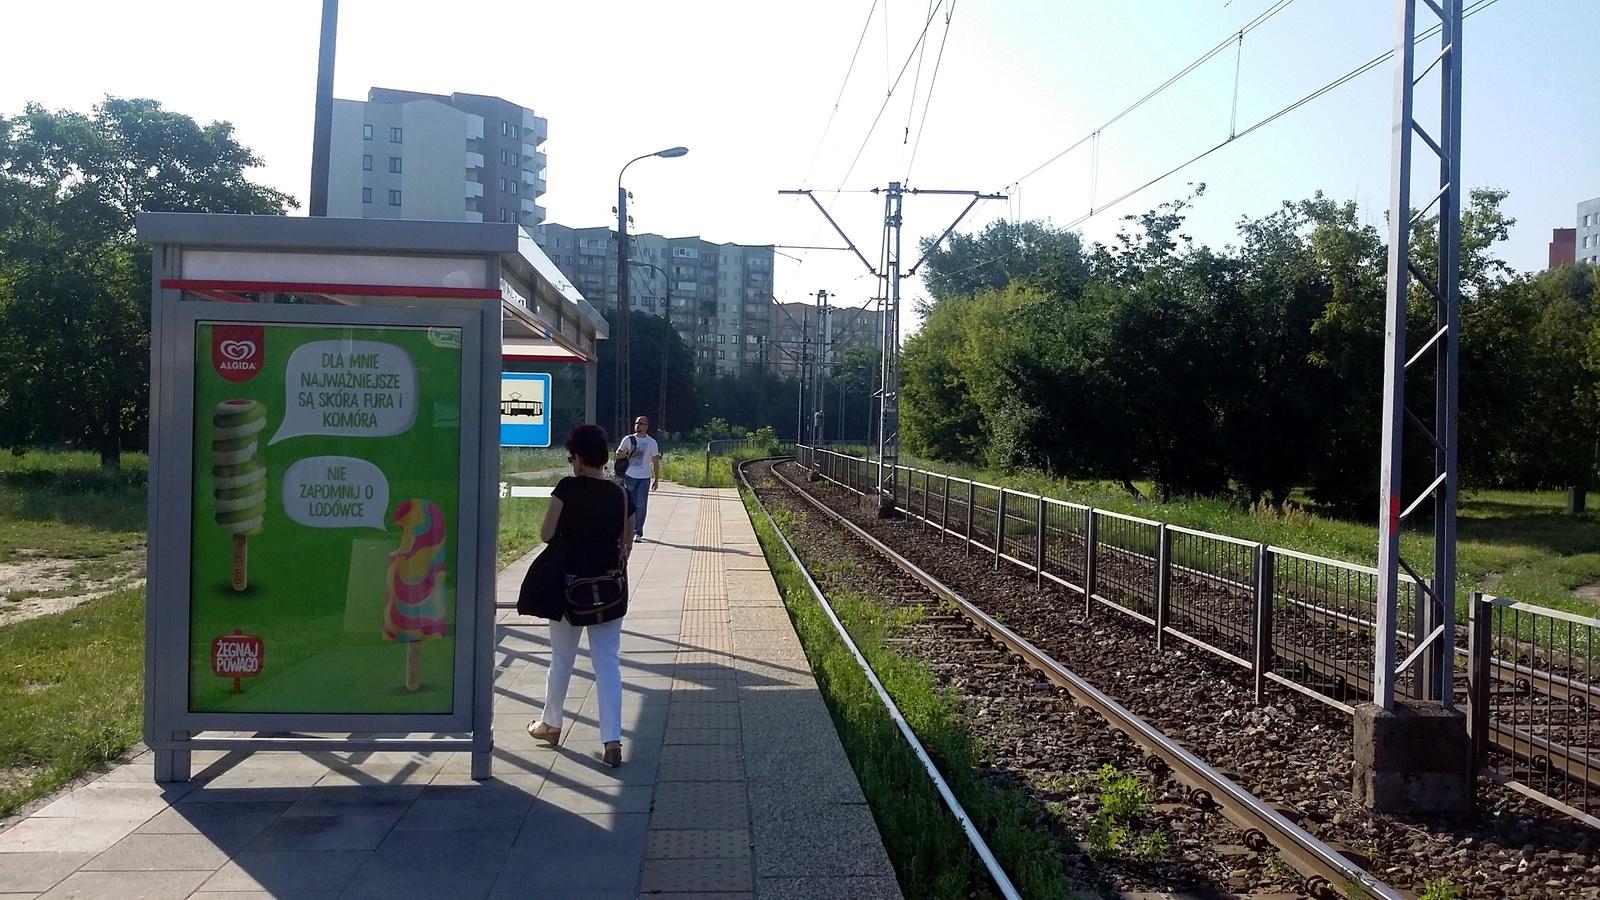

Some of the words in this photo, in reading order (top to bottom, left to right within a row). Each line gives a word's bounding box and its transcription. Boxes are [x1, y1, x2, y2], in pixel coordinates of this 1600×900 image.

[220, 361, 256, 370] ALGIDA
[322, 353, 345, 368] DLA
[349, 353, 379, 369] MNIE
[298, 392, 316, 409] SĄ
[319, 390, 359, 408] SKÓRA
[364, 393, 394, 409] FURA
[323, 409, 378, 428] KOMÓRA
[299, 484, 360, 500] ZAPOMNIJ
[365, 484, 374, 500] O
[309, 499, 364, 518] LODÓWCE
[216, 639, 259, 657] ŻEGNAJ
[216, 656, 258, 672] POWAGO
